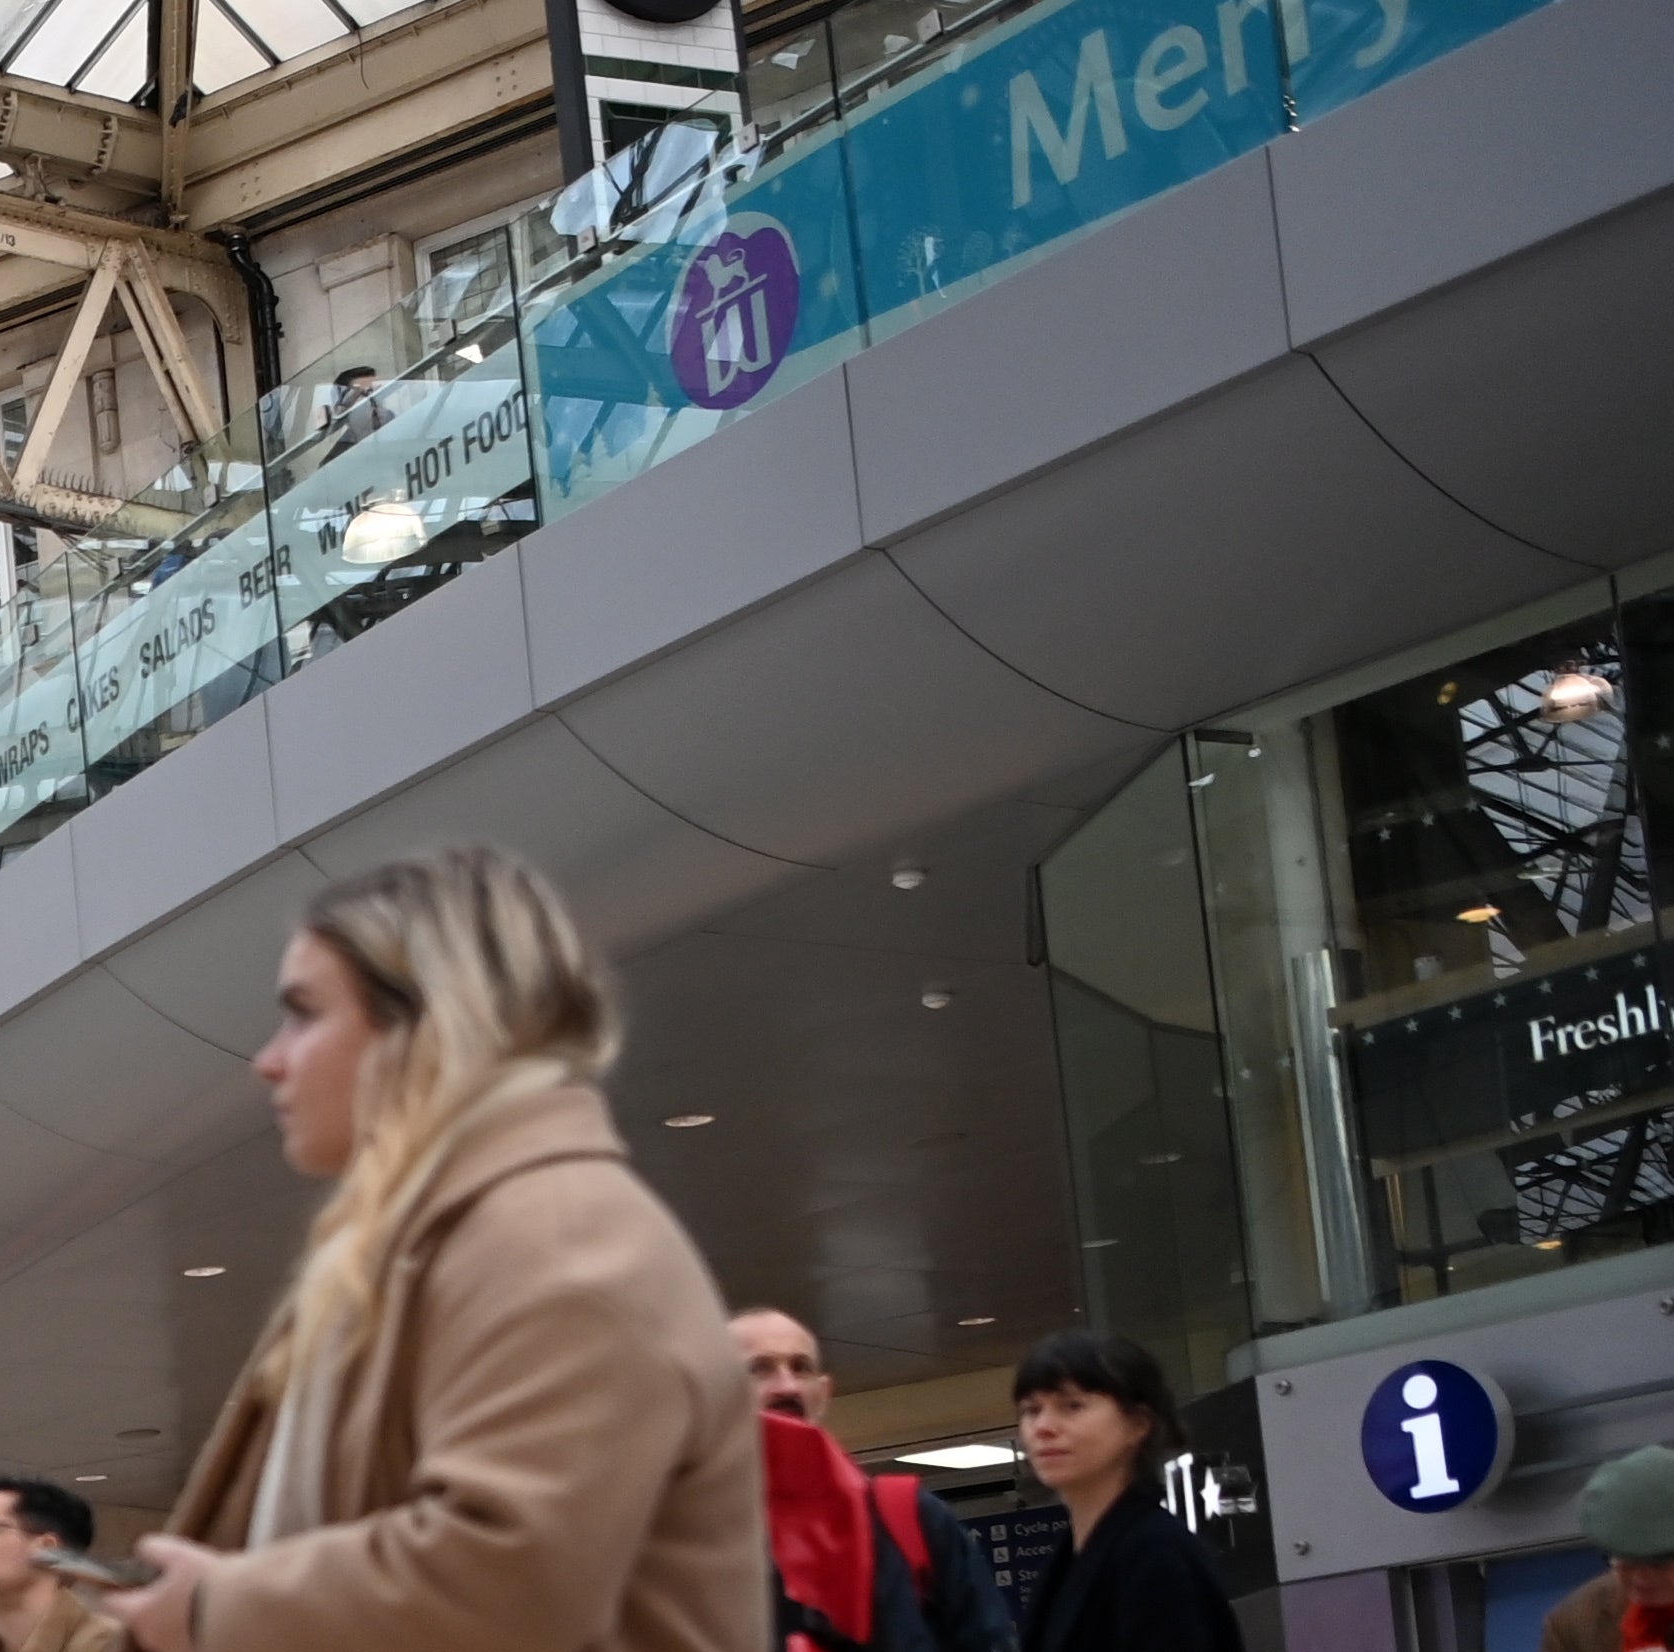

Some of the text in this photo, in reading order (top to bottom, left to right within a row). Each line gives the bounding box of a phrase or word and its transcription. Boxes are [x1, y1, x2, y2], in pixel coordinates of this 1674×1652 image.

[405, 389, 528, 500] HOT FOOD
[239, 544, 292, 609] BEER
[139, 598, 215, 679] SALADS
[67, 665, 120, 733] CAKES
[1528, 984, 1669, 1062] Freshl
[1014, 1522, 1050, 1536] Cycle
